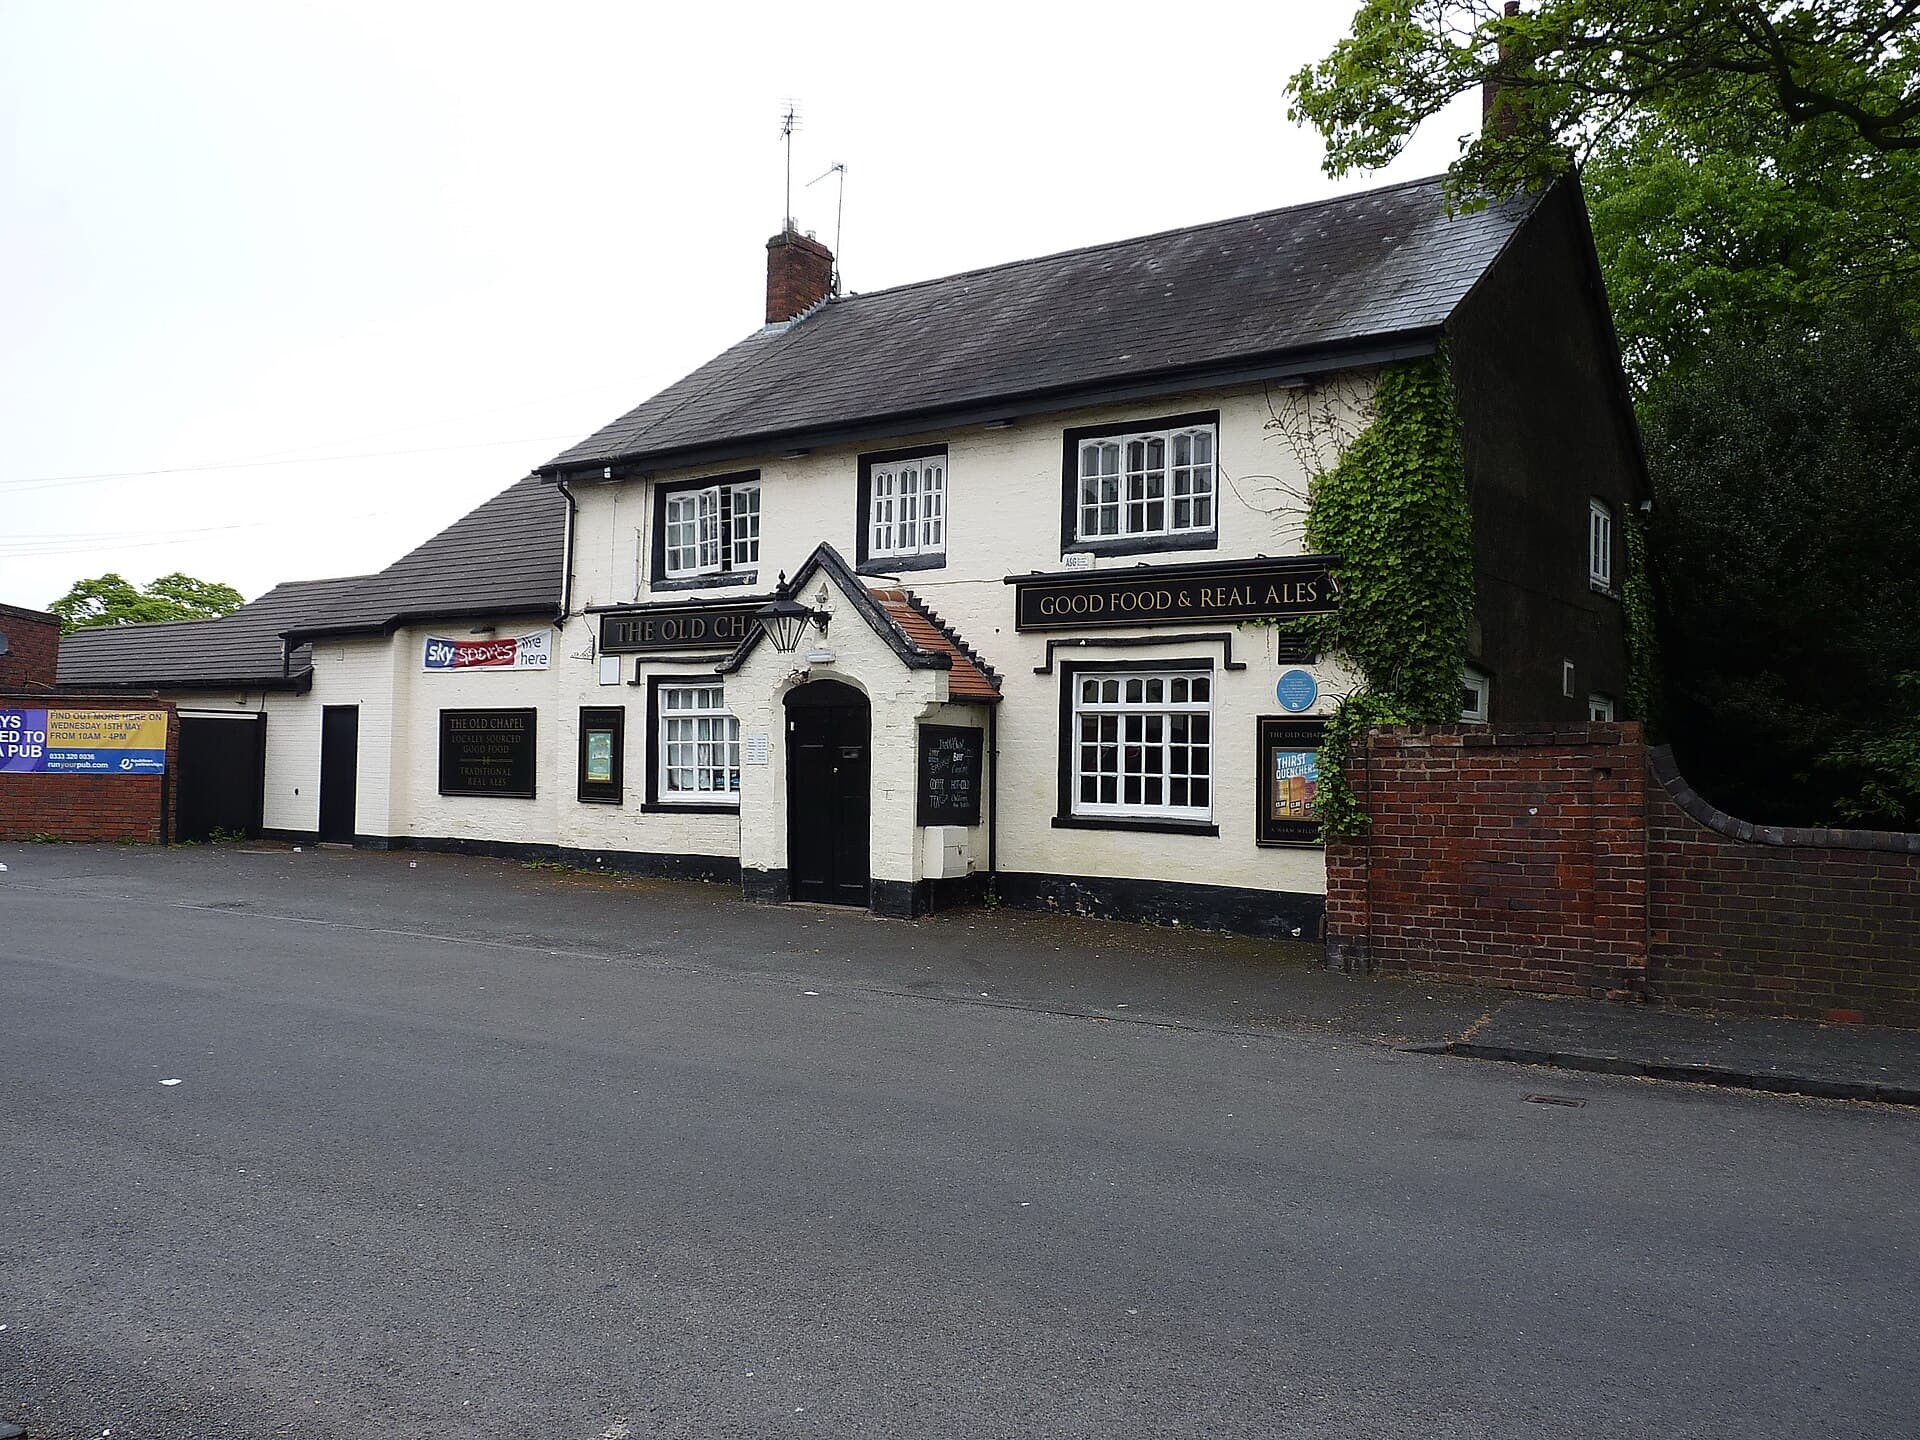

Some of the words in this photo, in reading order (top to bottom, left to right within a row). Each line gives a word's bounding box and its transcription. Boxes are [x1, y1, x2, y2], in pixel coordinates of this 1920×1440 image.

[1040, 593, 1104, 616] GOOD
[1110, 590, 1172, 612] FOOD
[1178, 590, 1192, 607] &
[1200, 586, 1257, 608] REAL
[1264, 581, 1318, 604] ALES
[616, 620, 656, 642] THE
[661, 618, 706, 641] OLD
[428, 642, 455, 666] sky
[459, 643, 513, 665] sports
[520, 651, 547, 665] here
[50, 712, 71, 720] FIND
[73, 712, 91, 720] OUT
[122, 713, 146, 721] HERE
[149, 713, 162, 721] ON
[50, 721, 101, 730] WEDNESDAY
[103, 722, 122, 730] 15TH
[125, 722, 141, 730] MAY
[450, 718, 468, 729] THE
[469, 718, 488, 729] OLD
[489, 718, 524, 729] CHAPEL
[23, 730, 45, 743] TO
[50, 732, 75, 740] FROM
[79, 732, 101, 740] 10AM
[108, 732, 126, 740] 4PM
[1284, 731, 1300, 739] OLD
[8, 744, 42, 758] PUB
[463, 744, 485, 753] GOOD
[48, 761, 109, 769] runyourpub.com
[1276, 752, 1307, 770] THIRST
[460, 767, 511, 777] TRADITIONAL
